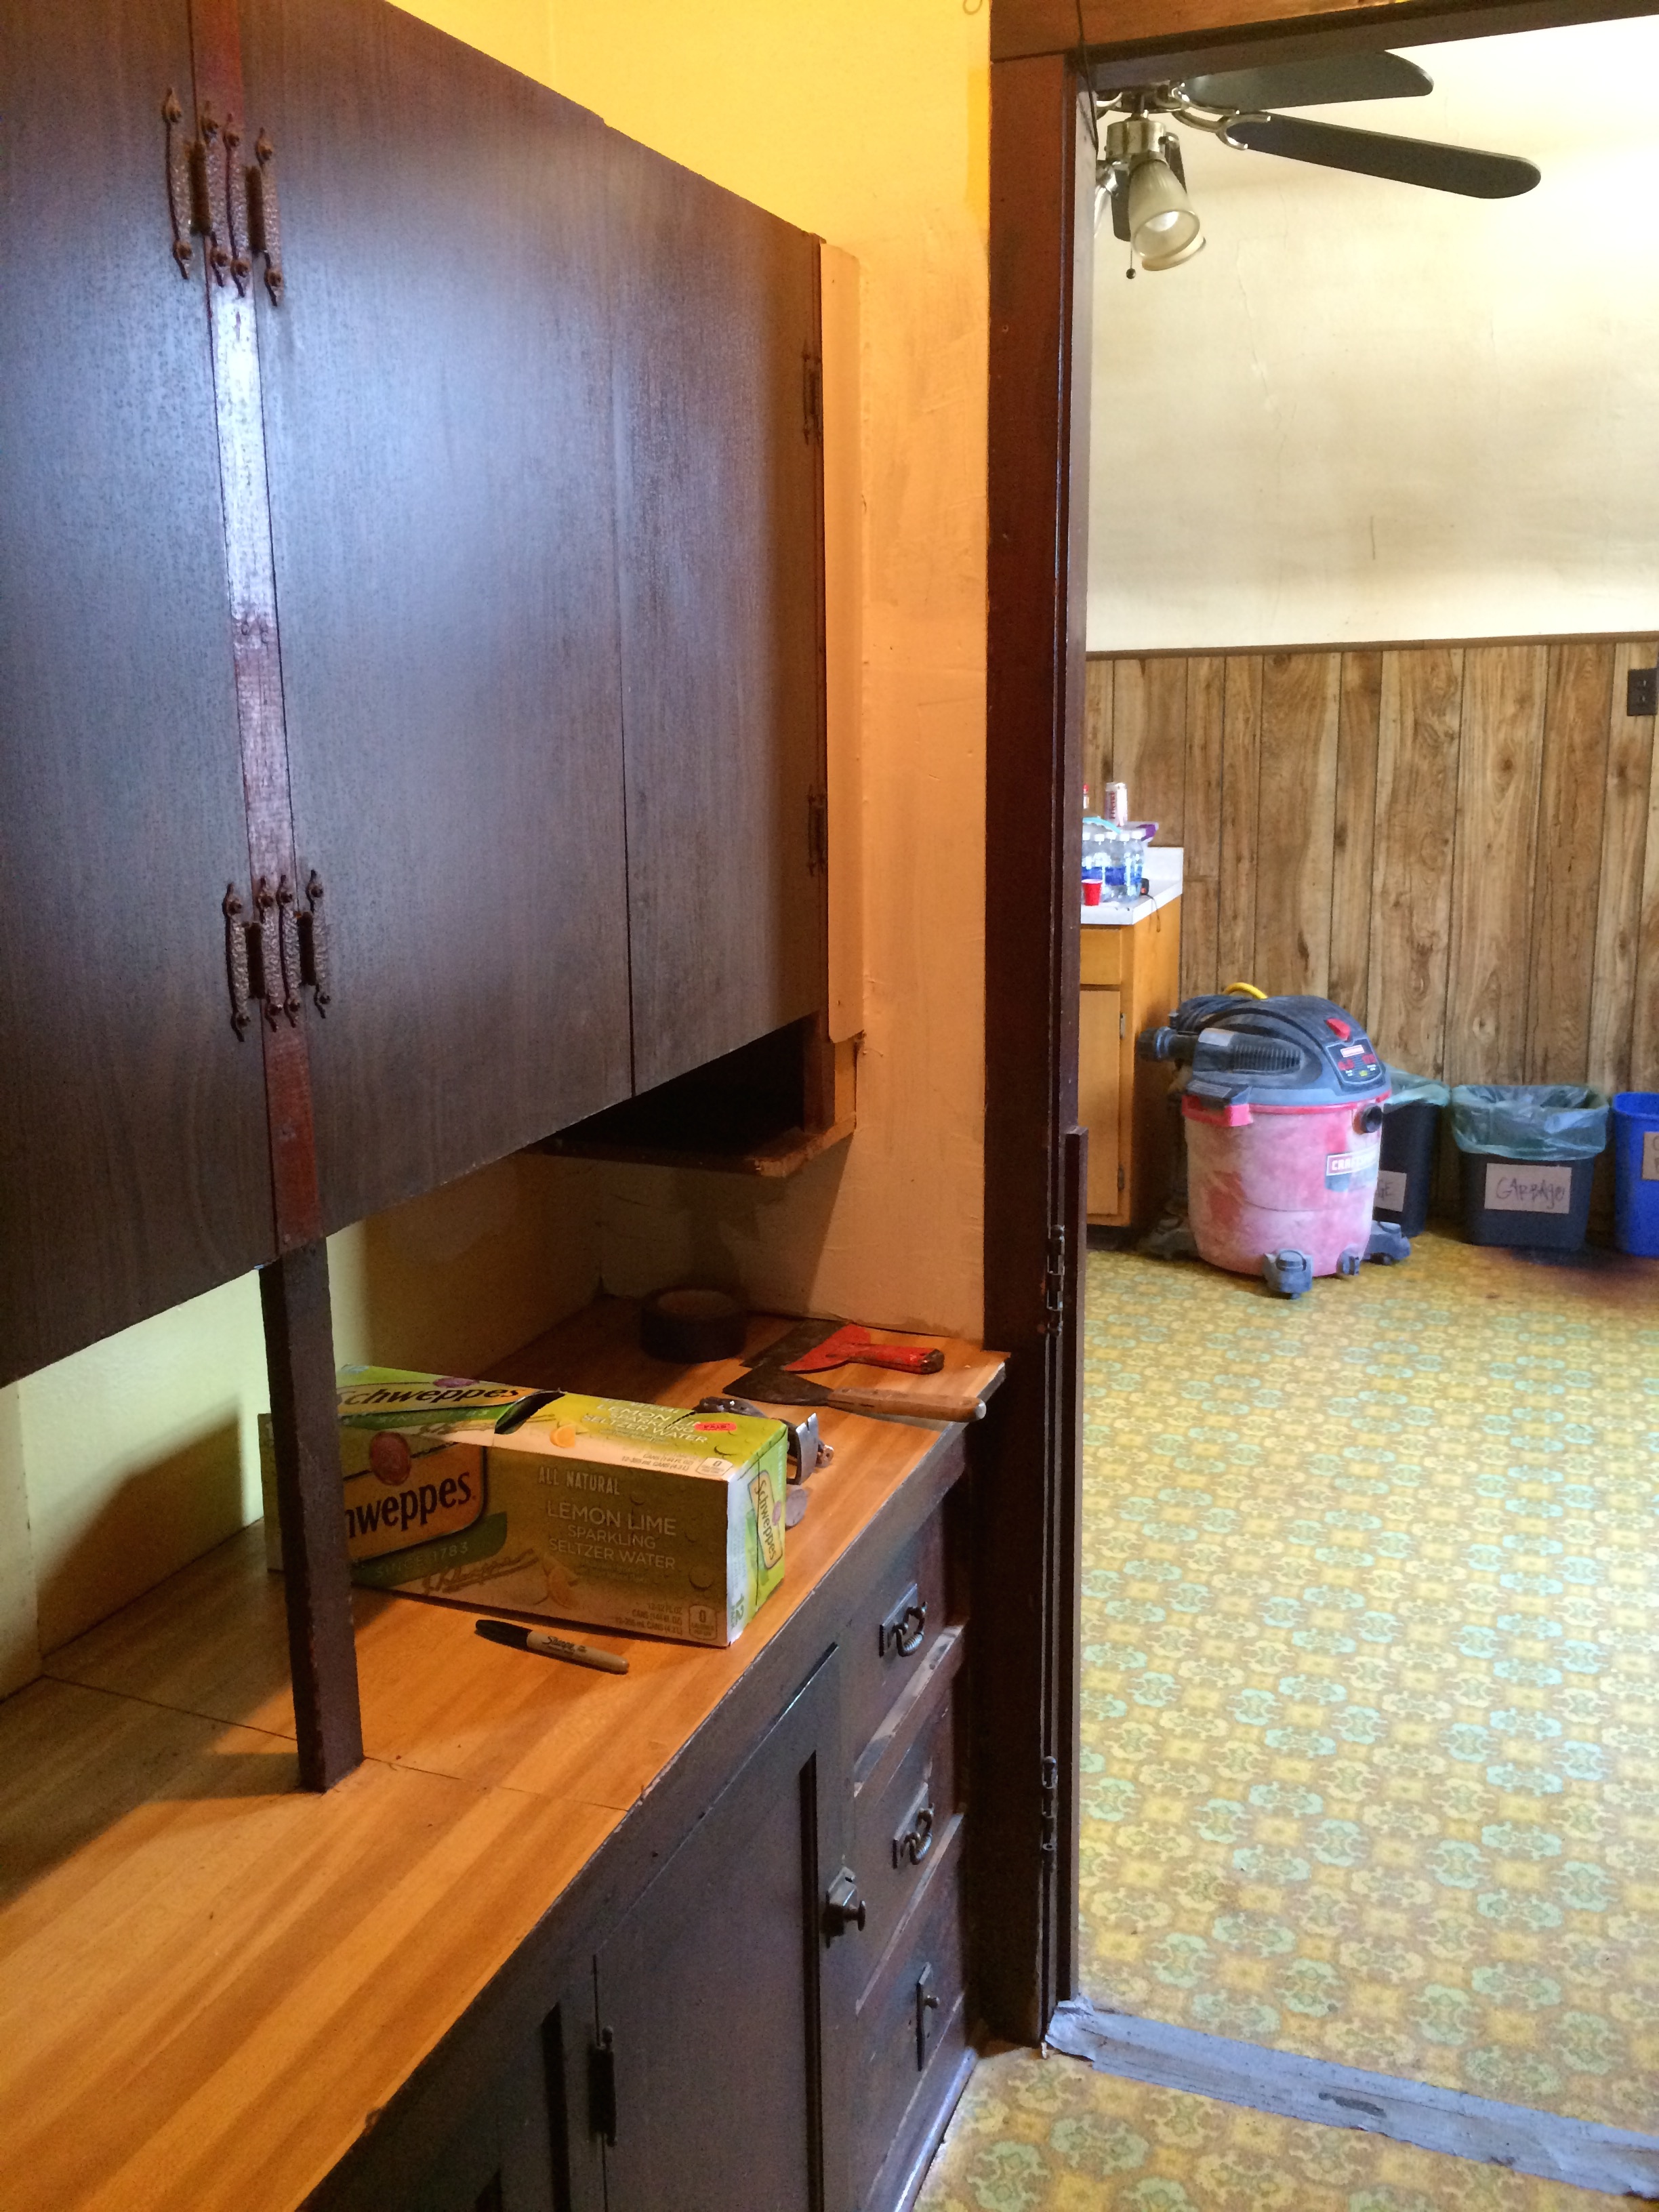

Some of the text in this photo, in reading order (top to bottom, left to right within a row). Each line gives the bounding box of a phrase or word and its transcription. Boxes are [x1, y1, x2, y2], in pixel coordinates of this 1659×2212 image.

[582, 1414, 649, 1431] SELTZER
[653, 1427, 709, 1443] WATER
[596, 1404, 672, 1421] LEMON
[676, 1418, 701, 1427] LI
[609, 1412, 696, 1433] SPARKLING
[539, 1467, 620, 1495] ALL NATURAL
[548, 1500, 677, 1536] LEMON LIME
[754, 1479, 777, 1560] Schweppes
[568, 1525, 656, 1549] SPARKLING
[375, 1555, 424, 1578] SINCE
[433, 1541, 468, 1561] 1783
[549, 1538, 676, 1570] SELTZER WATER
[699, 1610, 706, 1623] 0
